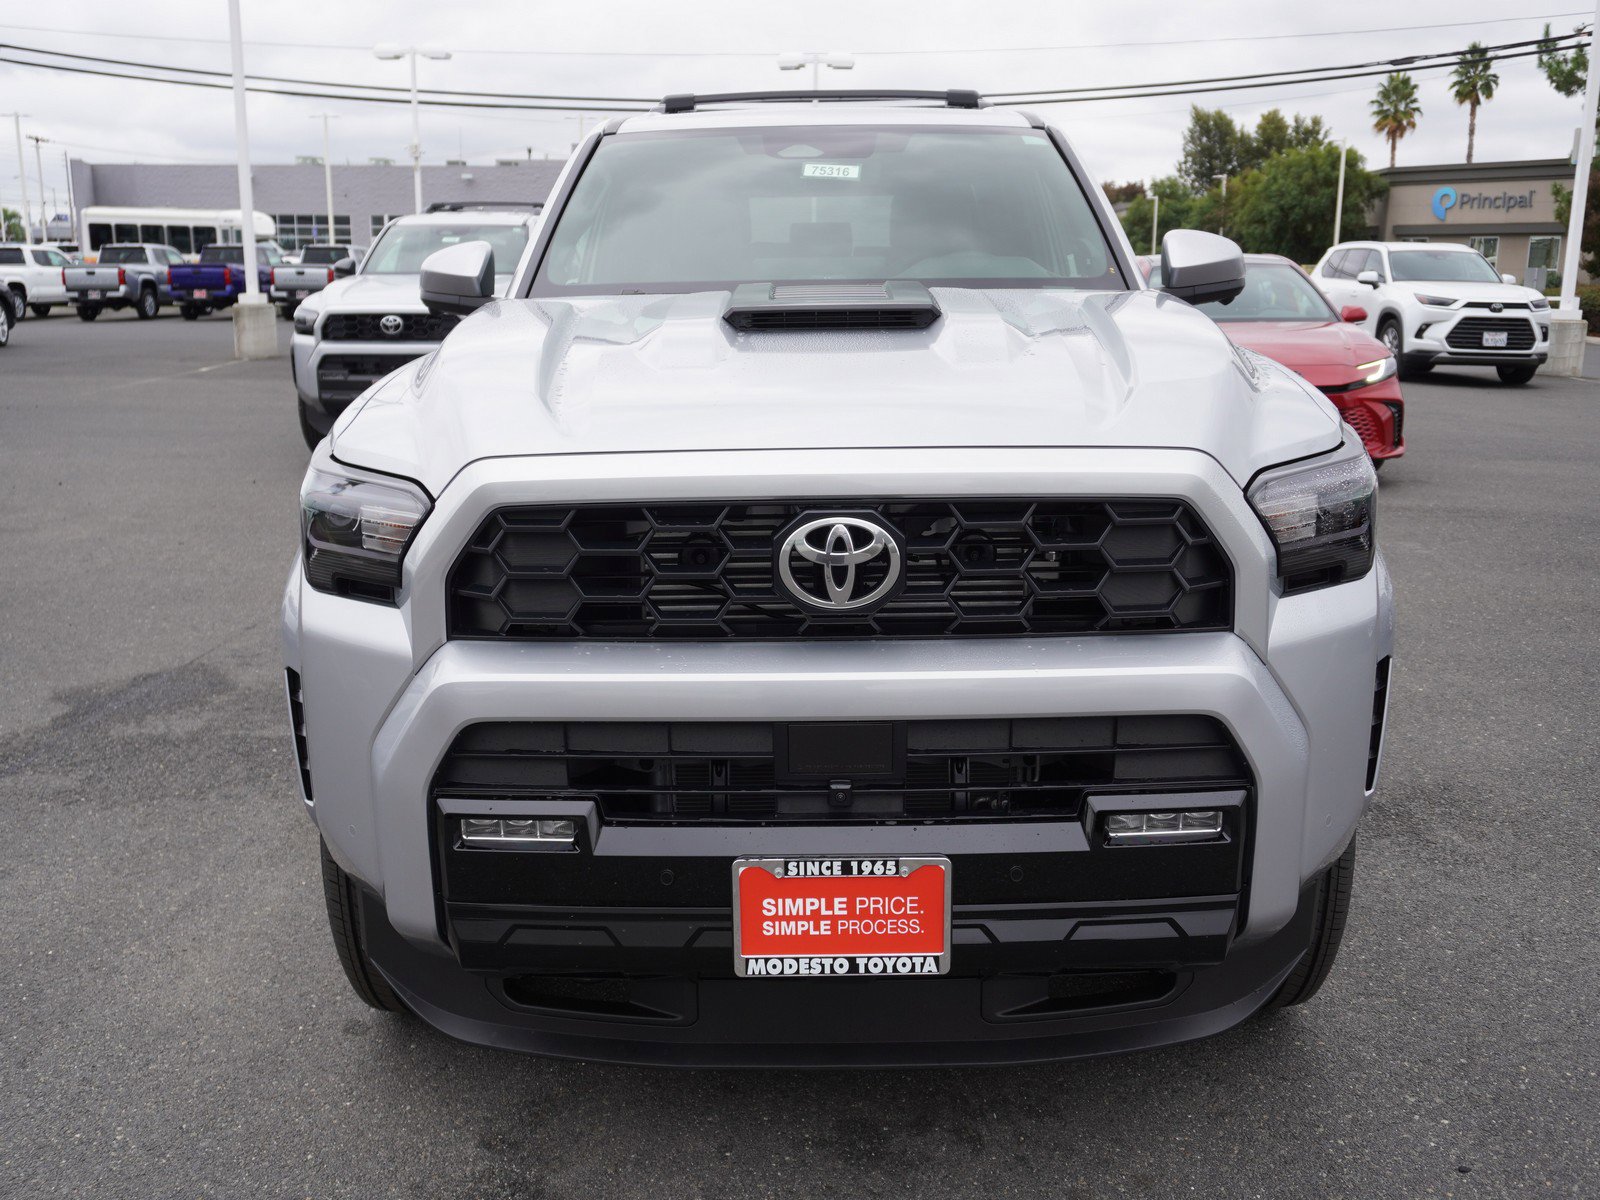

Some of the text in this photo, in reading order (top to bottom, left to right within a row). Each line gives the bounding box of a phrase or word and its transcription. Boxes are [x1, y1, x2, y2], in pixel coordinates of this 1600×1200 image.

[812, 166, 850, 177] 75316
[1459, 190, 1534, 213] Principal
[787, 861, 897, 876] SINCE 1965
[762, 896, 924, 916] SIMPLE PRICE.
[762, 919, 925, 936] SIMPLE PROCESS.
[747, 956, 938, 975] MODESTO TOYOTA
